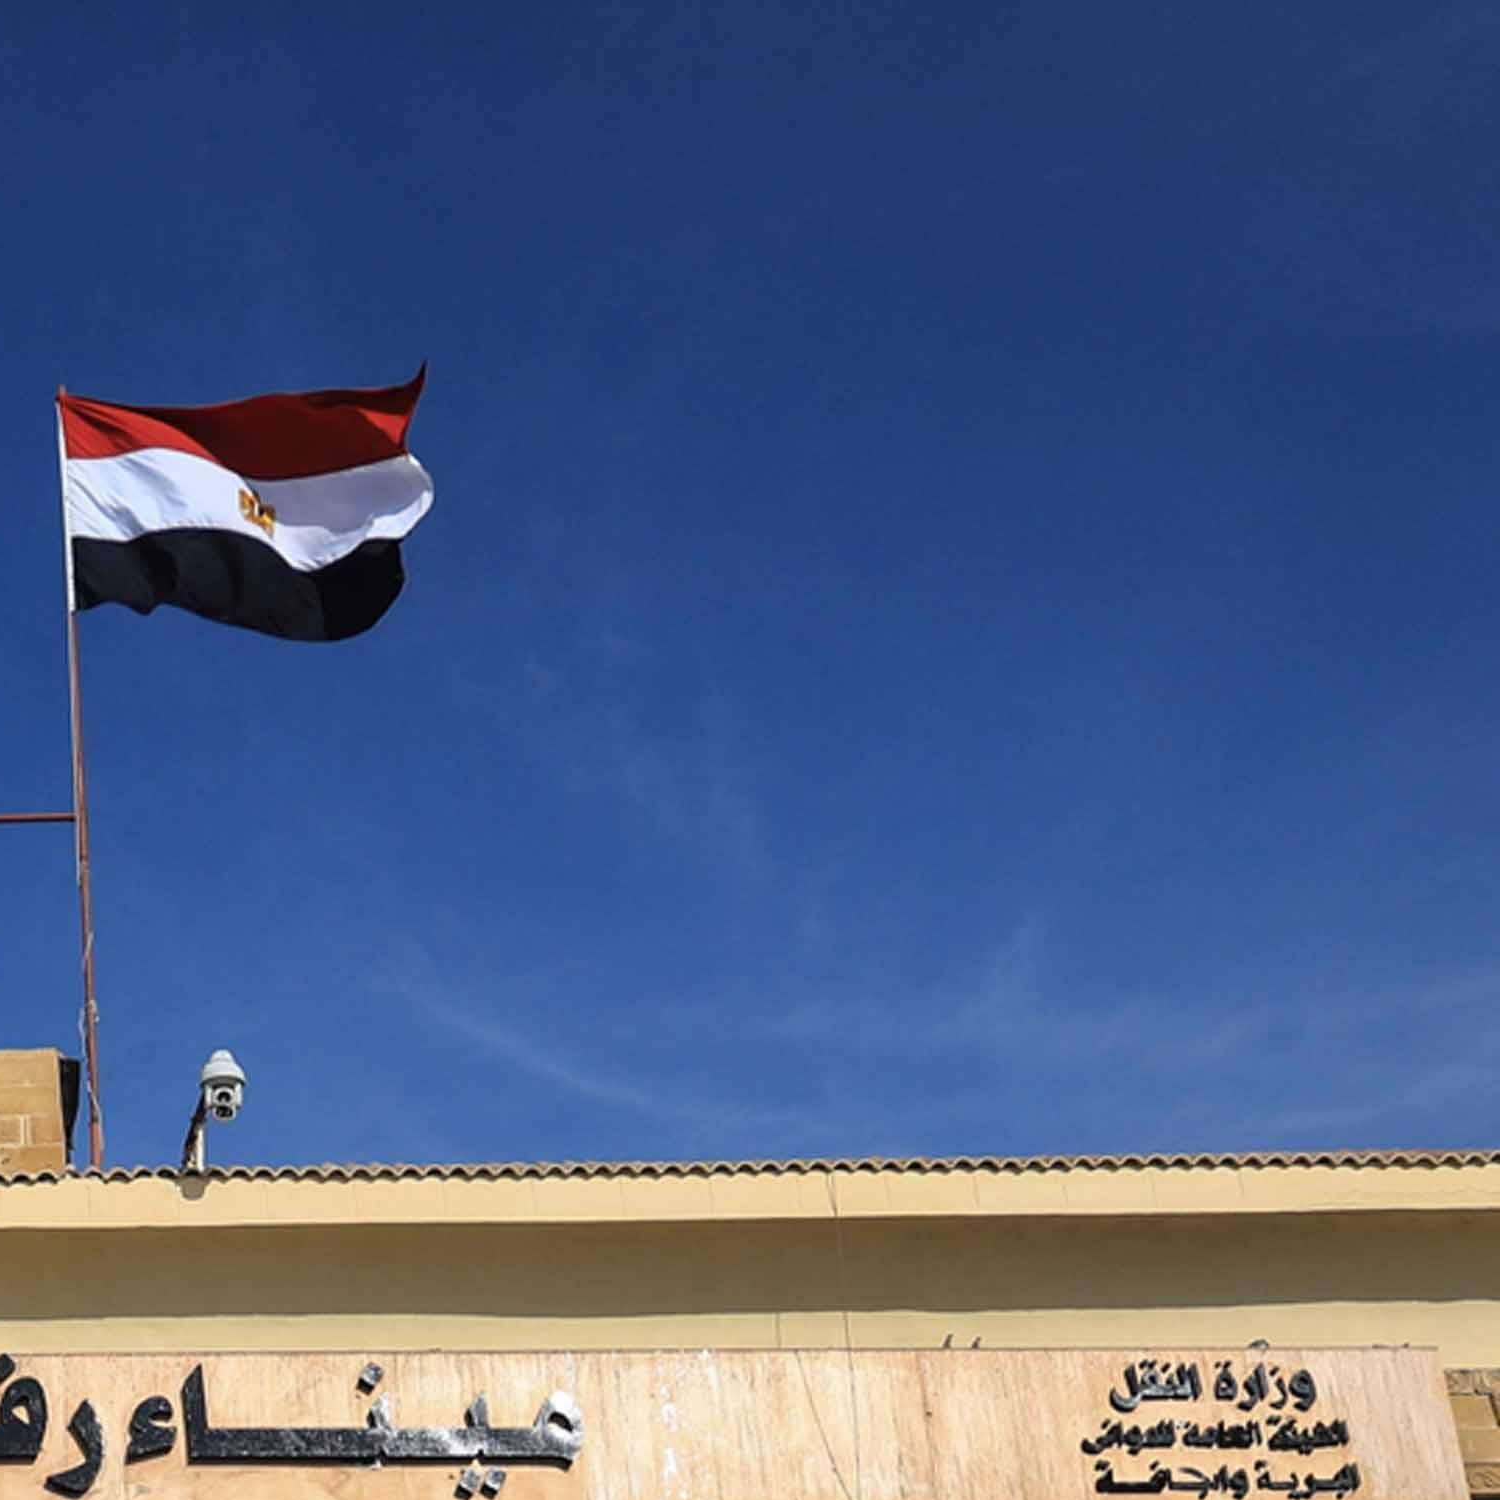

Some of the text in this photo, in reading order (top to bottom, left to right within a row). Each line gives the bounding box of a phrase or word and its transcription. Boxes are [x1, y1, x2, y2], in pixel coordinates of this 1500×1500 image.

[1109, 1360, 1316, 1412] وزارة النقل
[1177, 1420, 1262, 1449] العامة
[1267, 1415, 1349, 1455] الهيئة
[1254, 1460, 1361, 1500] البرية
